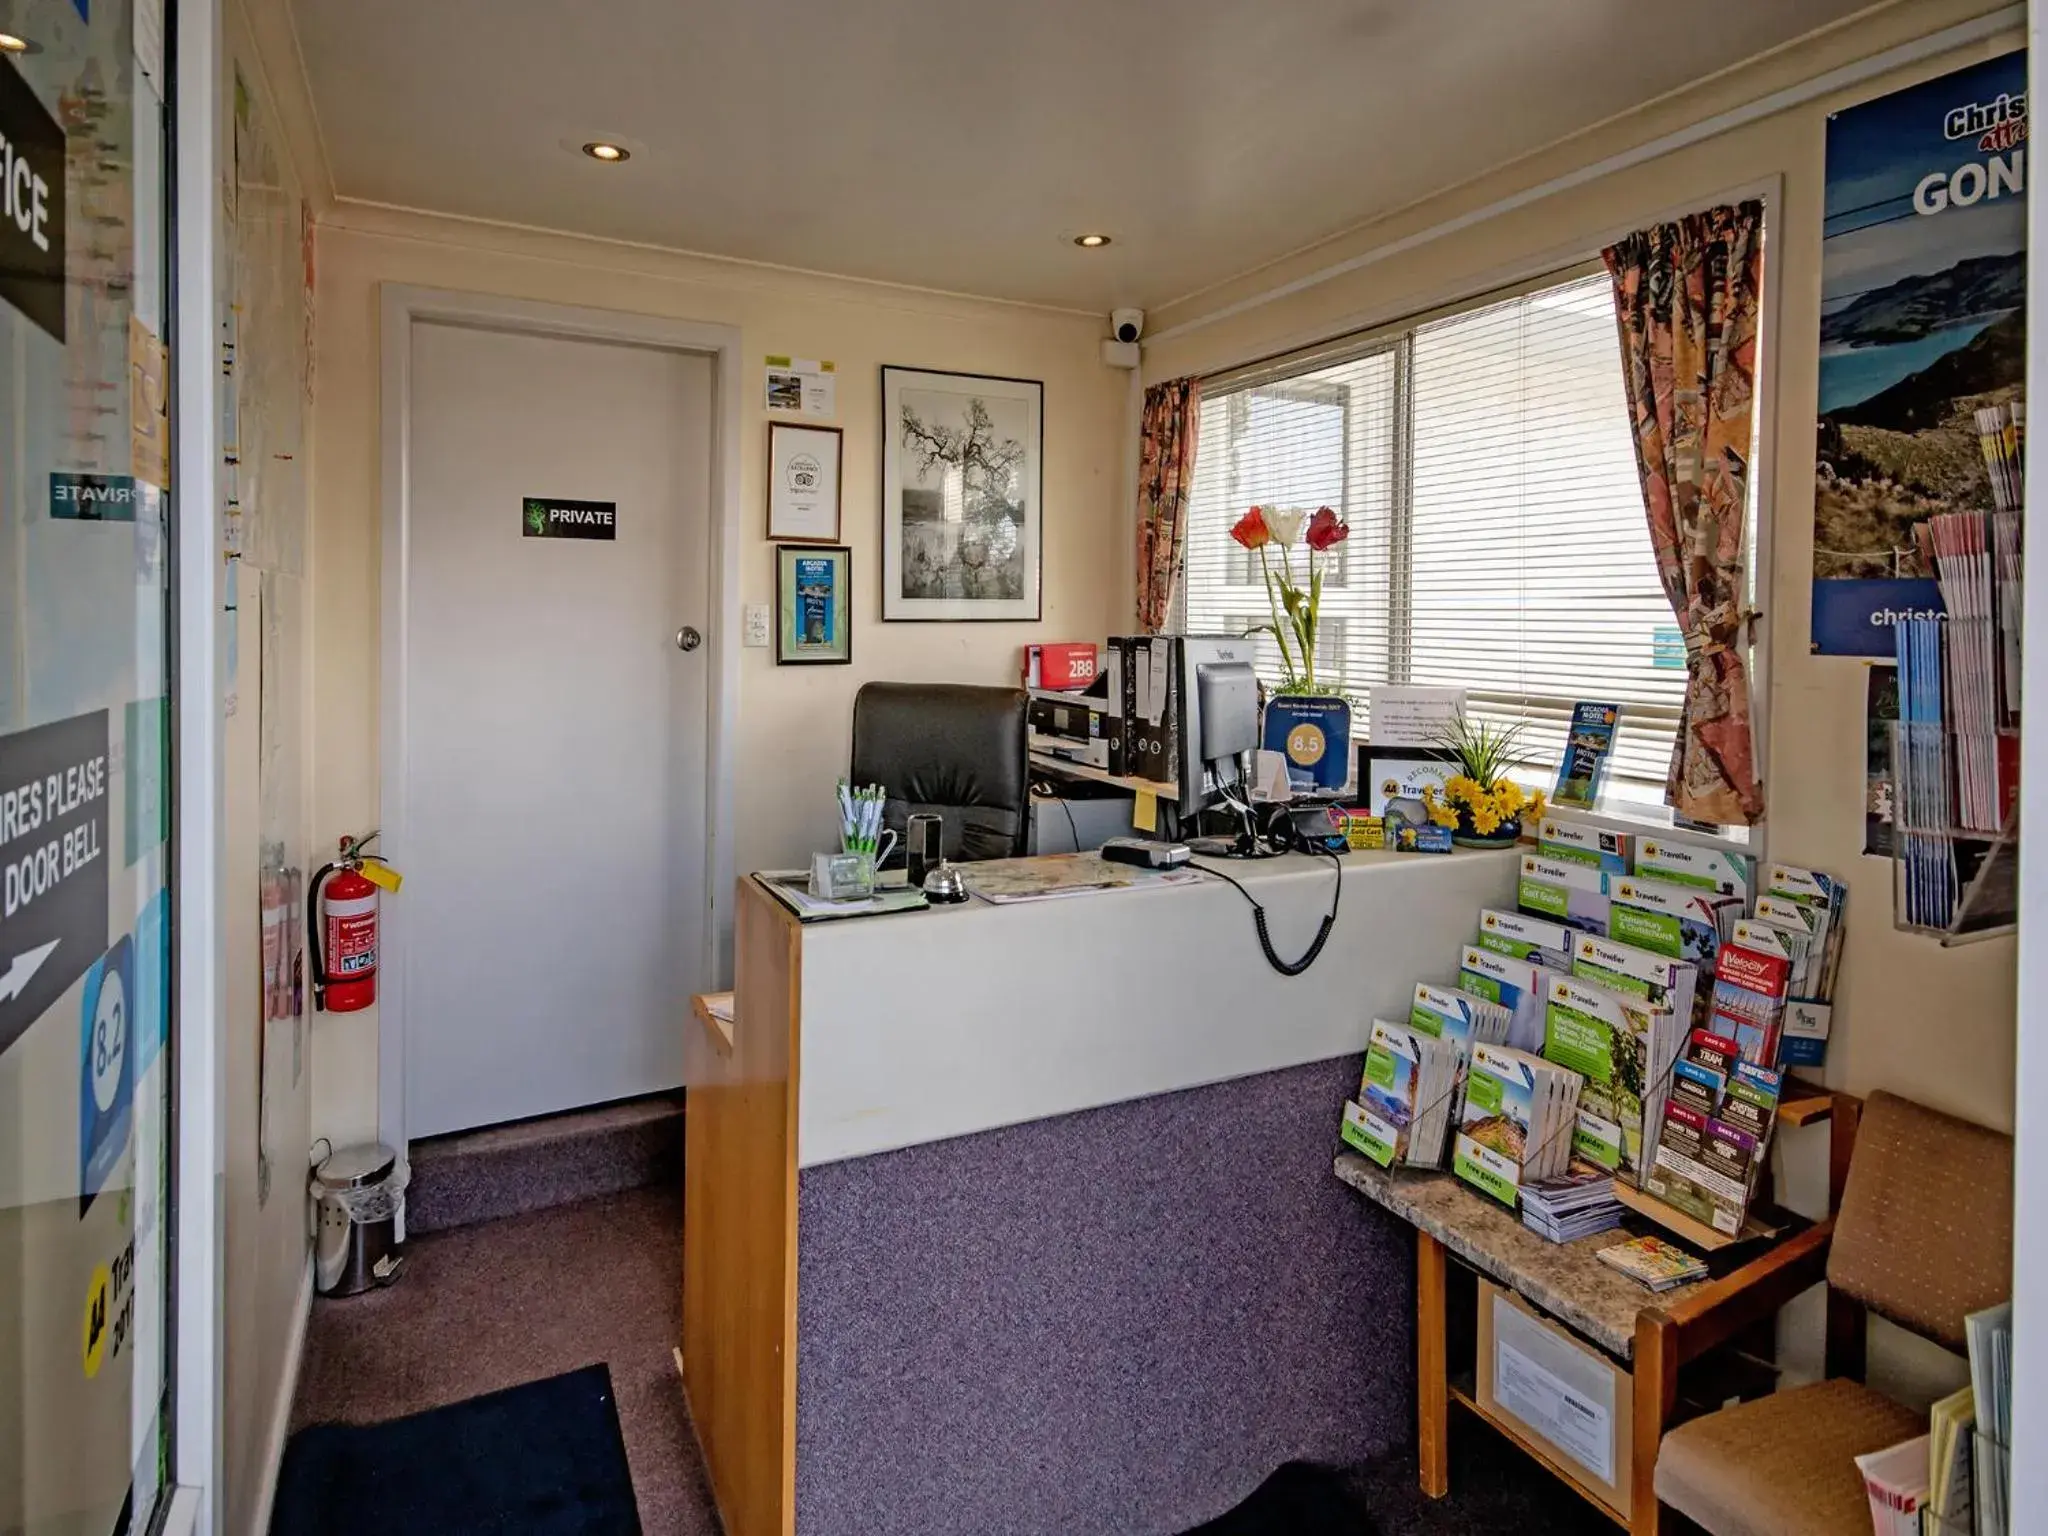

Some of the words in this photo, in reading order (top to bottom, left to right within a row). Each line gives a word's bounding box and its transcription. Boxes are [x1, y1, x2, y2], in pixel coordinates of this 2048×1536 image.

[1913, 149, 2024, 215] GON
[549, 508, 613, 525] PRIVATE
[1069, 659, 1093, 678] 2B8
[1293, 735, 1319, 753] 8.5
[47, 756, 104, 822] PLEASE
[1557, 828, 1584, 841] Traveller
[1659, 848, 1692, 862] Traveller
[5, 840, 60, 918] DOOR
[63, 818, 100, 878] BELL
[1537, 863, 1567, 879] Traveller
[1787, 875, 1812, 885] Traveller
[1635, 889, 1667, 904] Traveller
[1771, 907, 1797, 920] Traveller
[1498, 919, 1524, 933] Traveller
[1749, 932, 1775, 944] Traveller
[1596, 949, 1625, 965] Traveller
[1727, 951, 1770, 976] Velocity
[1480, 959, 1505, 974] Traveller
[1571, 992, 1599, 1009] Traveller
[96, 1002, 122, 1078] 8.2
[1487, 1055, 1510, 1073] Traveller
[1700, 1050, 1723, 1066] TRAM
[1480, 1170, 1502, 1188] guides
